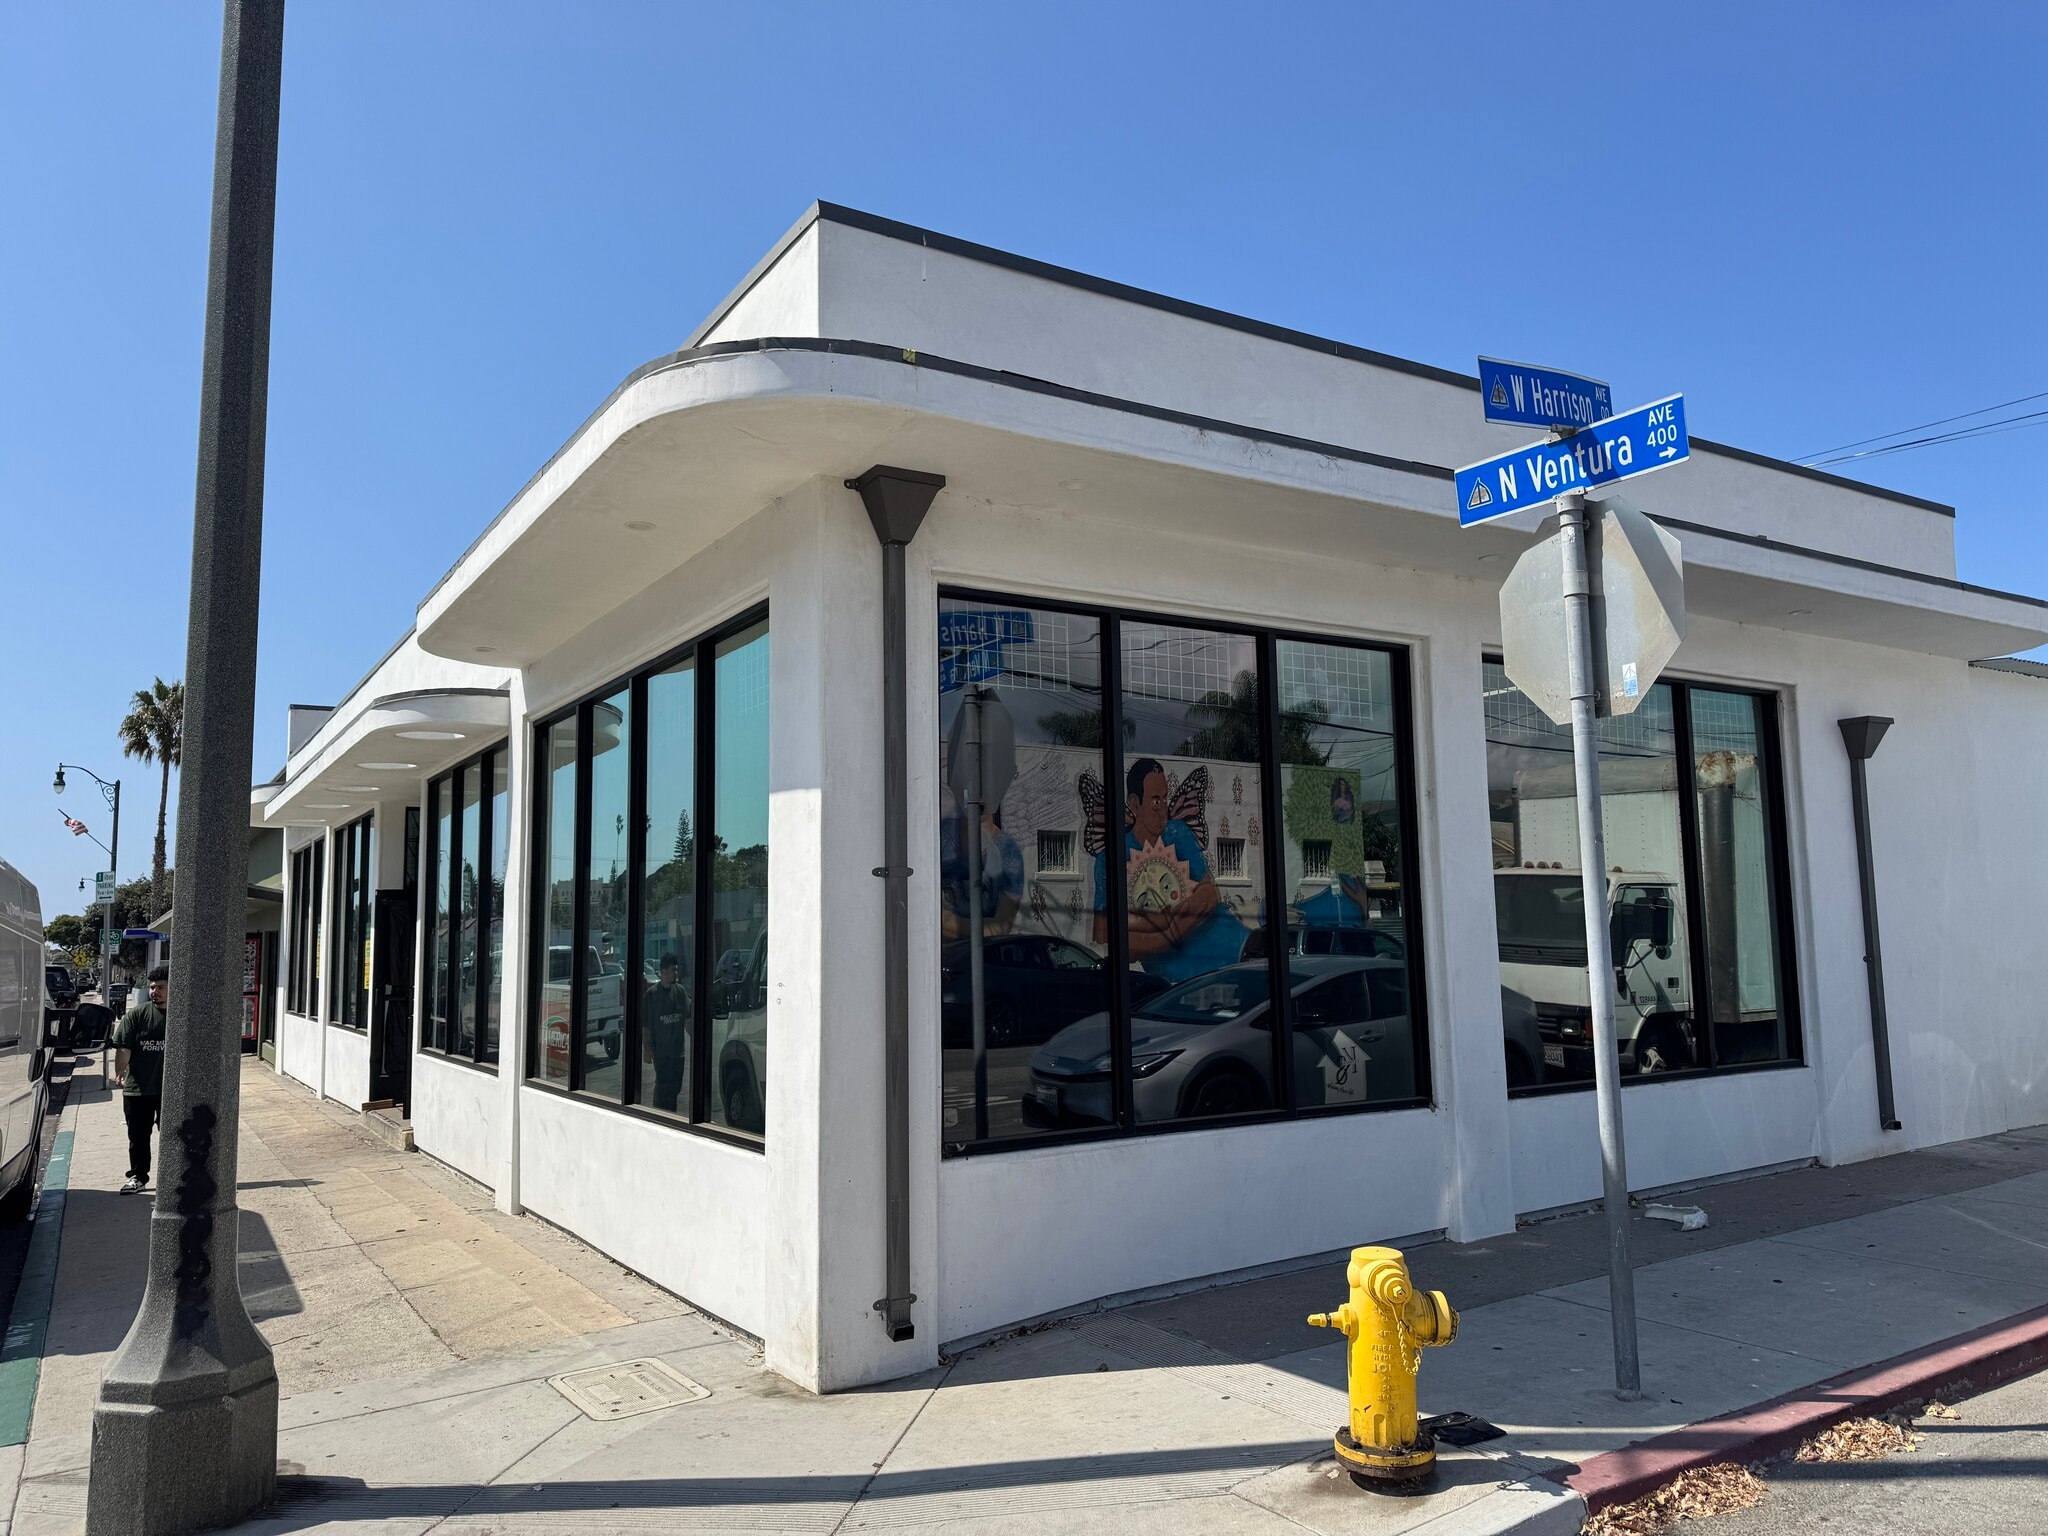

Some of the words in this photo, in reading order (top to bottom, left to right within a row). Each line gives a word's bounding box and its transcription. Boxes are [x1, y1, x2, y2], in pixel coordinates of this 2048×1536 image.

[1510, 374, 1525, 413] W
[1531, 377, 1594, 424] Harrison
[1595, 386, 1608, 403] AVE
[1648, 403, 1675, 428] AVE
[1646, 424, 1677, 447] 400
[1498, 464, 1518, 503] N
[1526, 435, 1633, 493] Ventura
